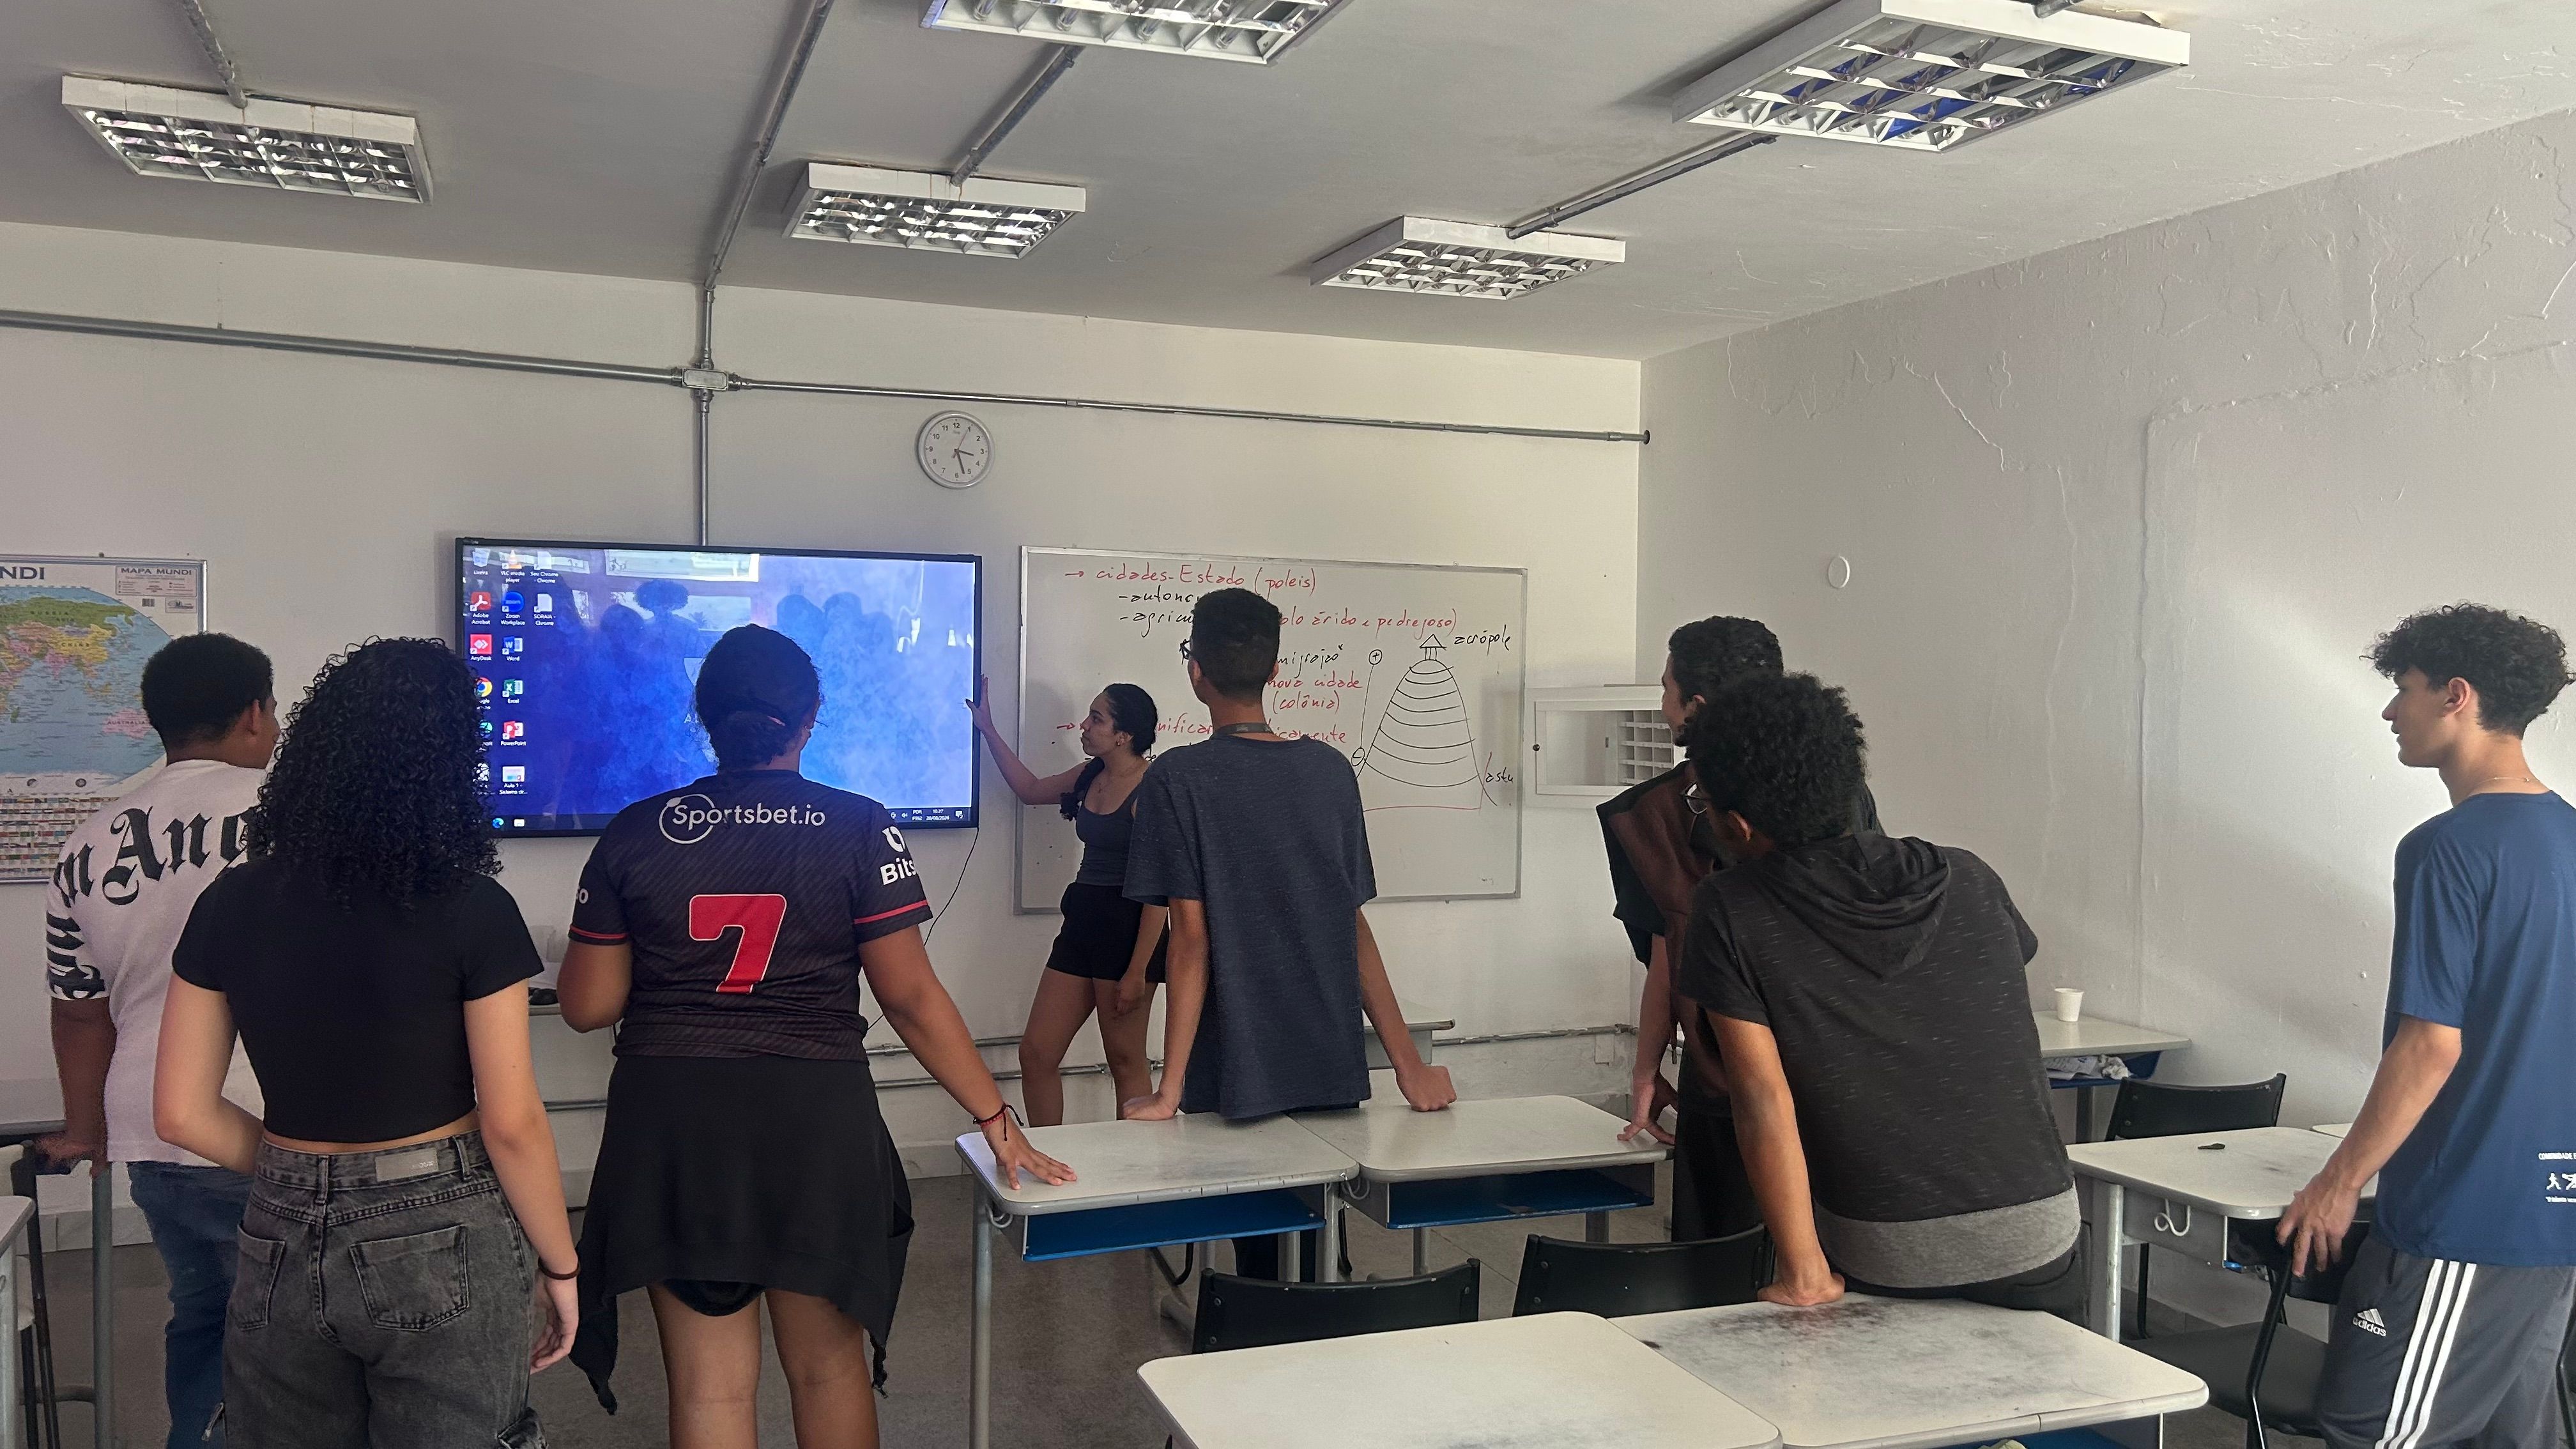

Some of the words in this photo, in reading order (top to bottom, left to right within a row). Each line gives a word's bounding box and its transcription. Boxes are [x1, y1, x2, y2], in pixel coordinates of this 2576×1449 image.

[1453, 624, 1511, 656] acrópole
[1314, 670, 1363, 689] cidade
[1273, 689, 1340, 715] (colônia)
[672, 802, 826, 831] Sportsbet.io
[689, 893, 787, 995] 7
[2352, 1317, 2386, 1337] adidas
